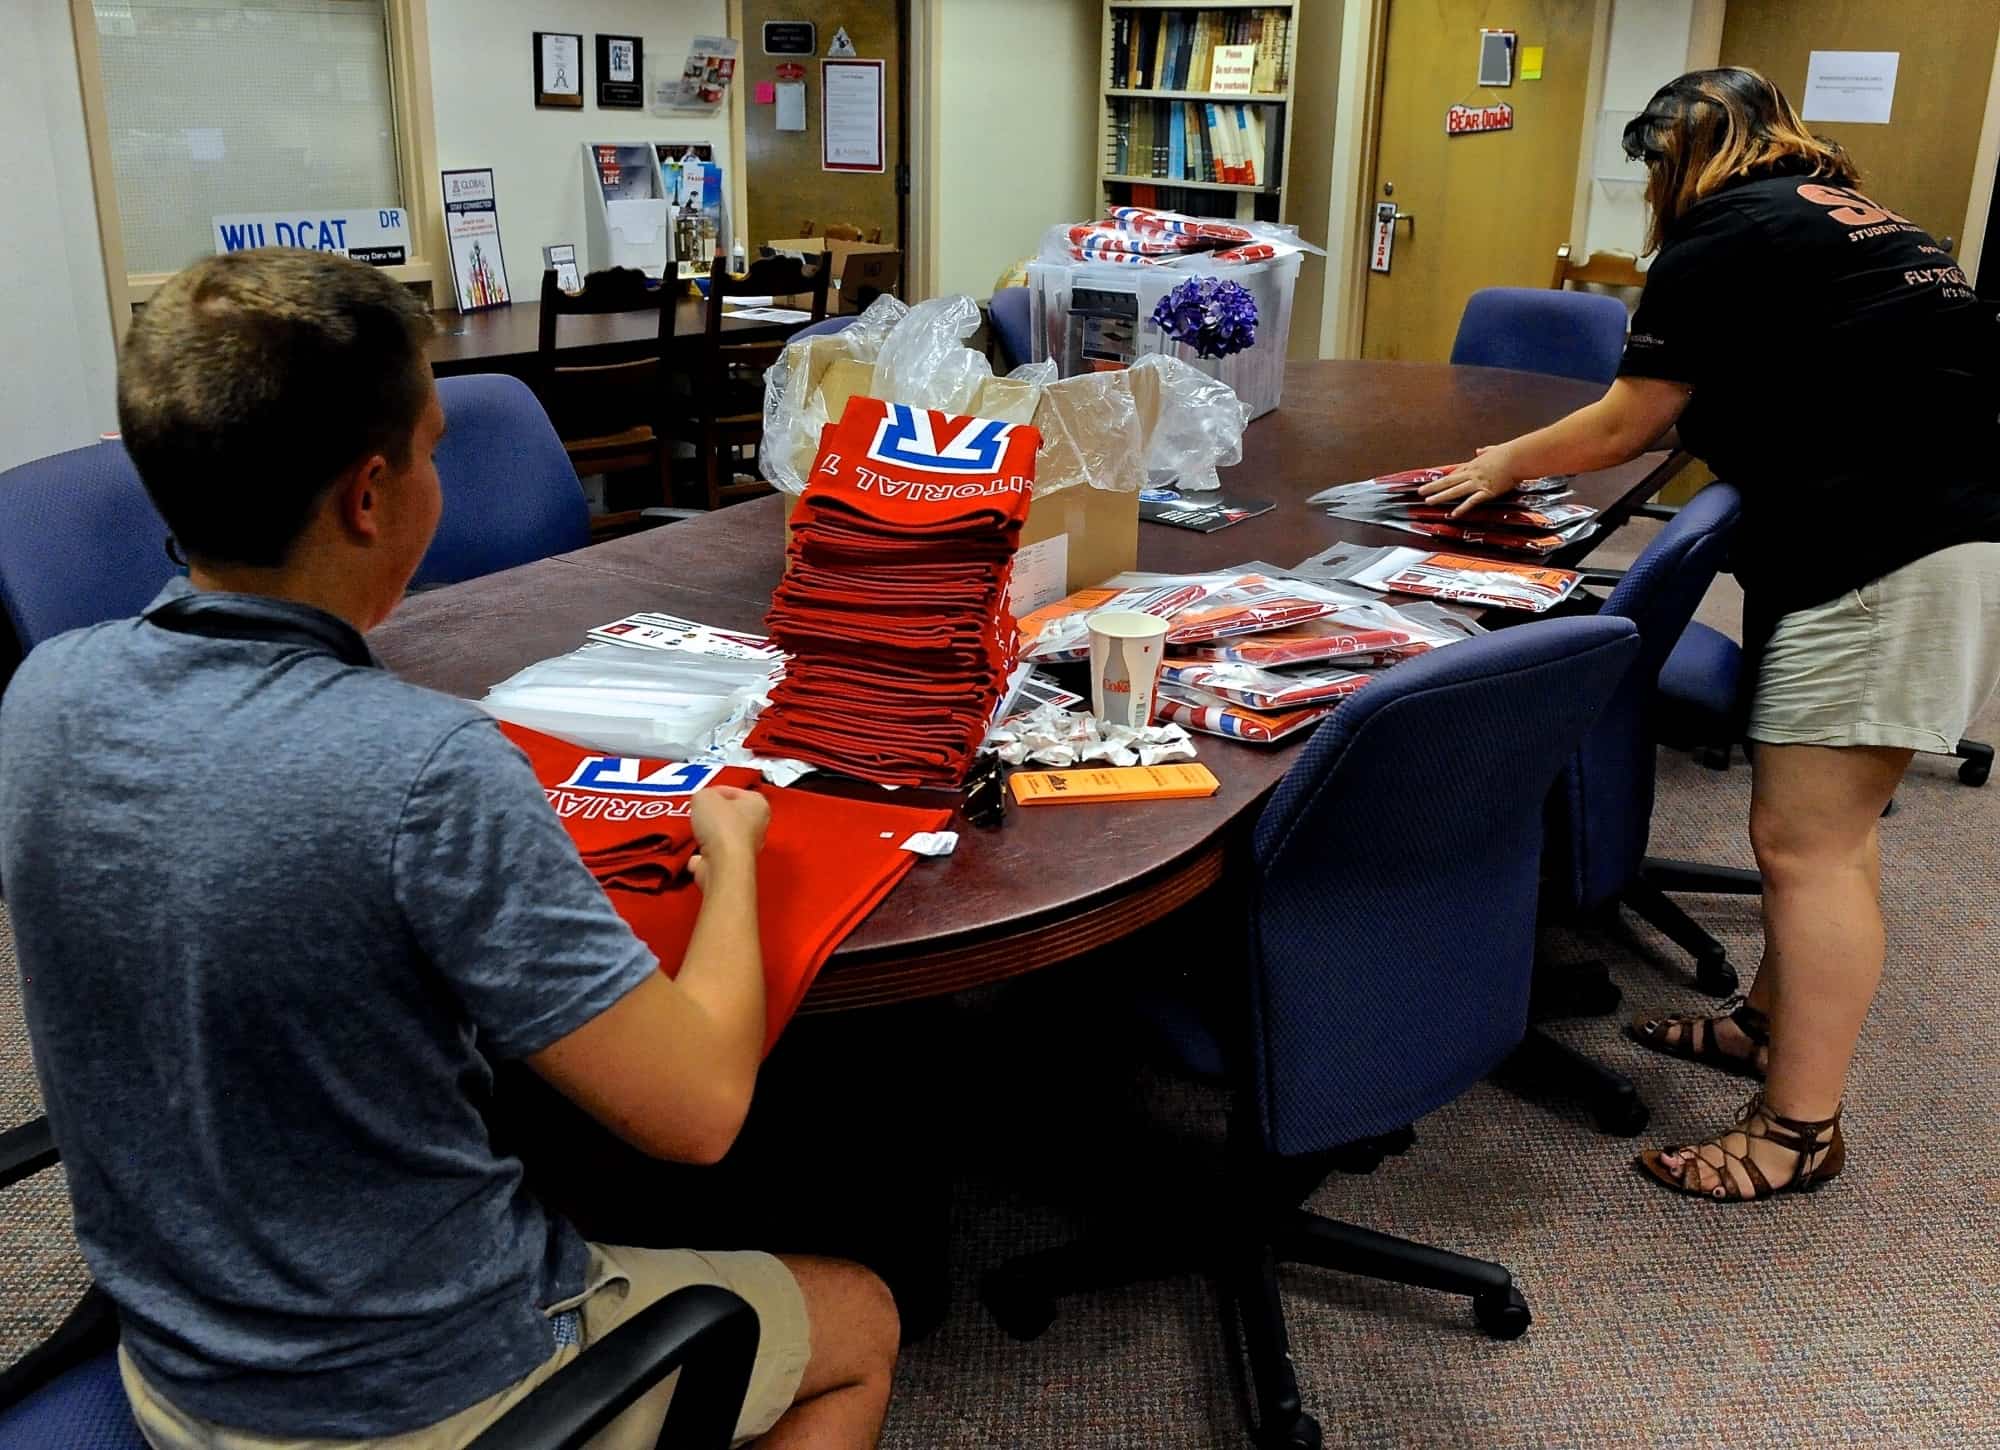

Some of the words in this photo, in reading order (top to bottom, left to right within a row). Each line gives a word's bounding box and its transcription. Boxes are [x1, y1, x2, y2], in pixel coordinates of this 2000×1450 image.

[1449, 109, 1479, 131] BEAR
[1482, 108, 1510, 128] DOWN
[379, 210, 401, 228] DR
[1848, 224, 1900, 242] STUDENT
